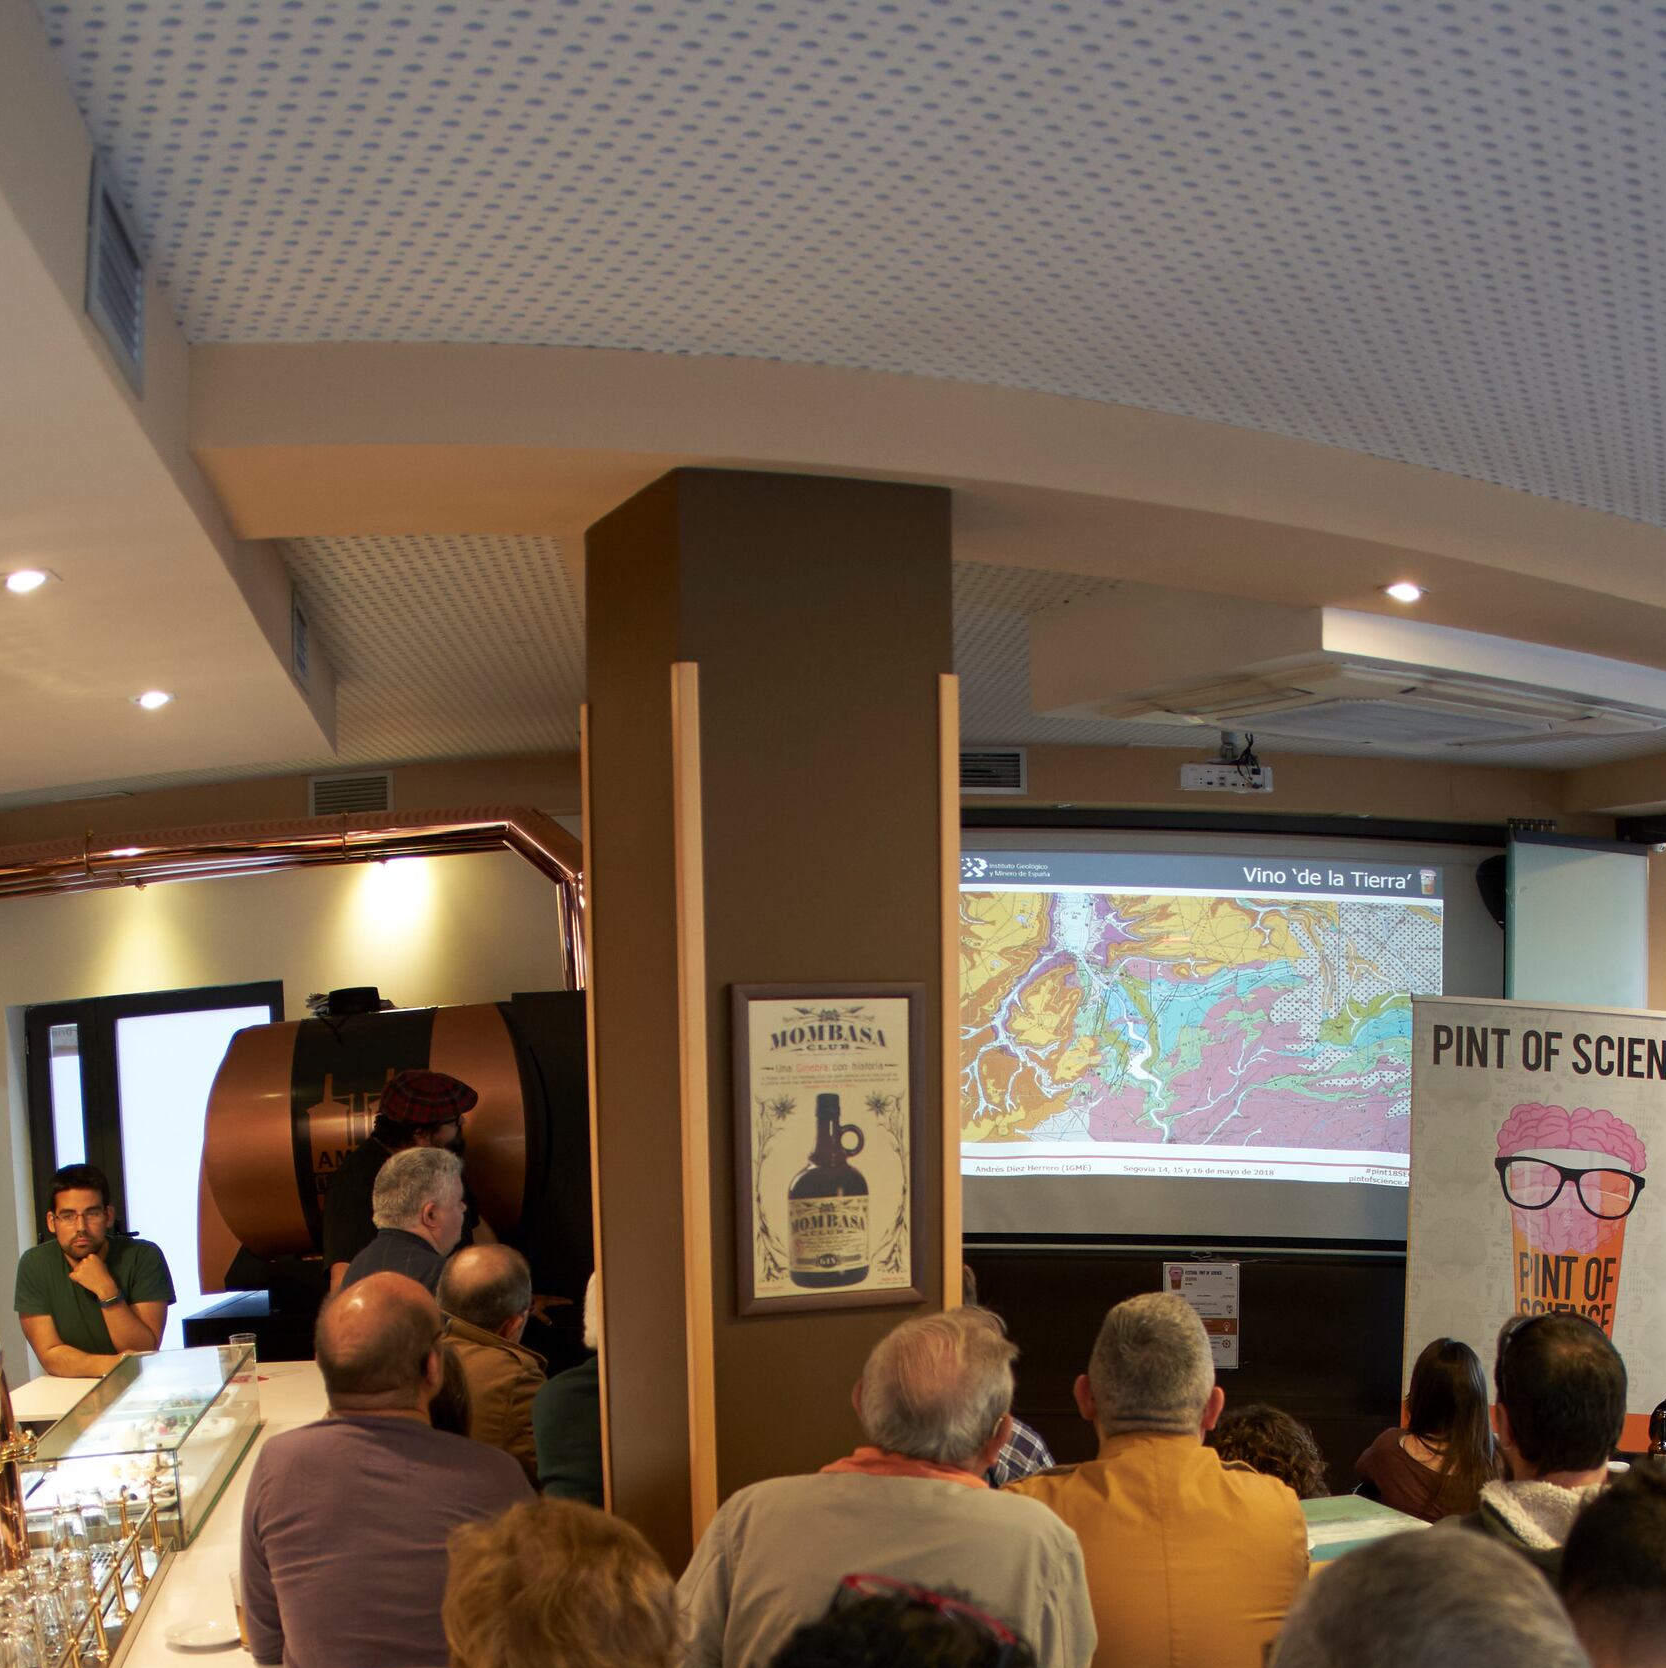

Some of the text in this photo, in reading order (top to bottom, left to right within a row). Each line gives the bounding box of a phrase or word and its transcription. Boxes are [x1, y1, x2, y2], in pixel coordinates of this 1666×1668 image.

[989, 863, 1015, 871] Instituto
[994, 870, 1017, 878] Minero
[1243, 867, 1286, 884] Vino
[1328, 870, 1344, 887] la
[770, 1024, 887, 1050] MOMBASA
[806, 1043, 850, 1051] CLUB
[1433, 1024, 1510, 1068] PINT
[1522, 1030, 1563, 1072] OF
[1254, 1168, 1274, 1176] 2018
[791, 1214, 865, 1232] MOMBASA
[1519, 1252, 1616, 1301] PINT OF
